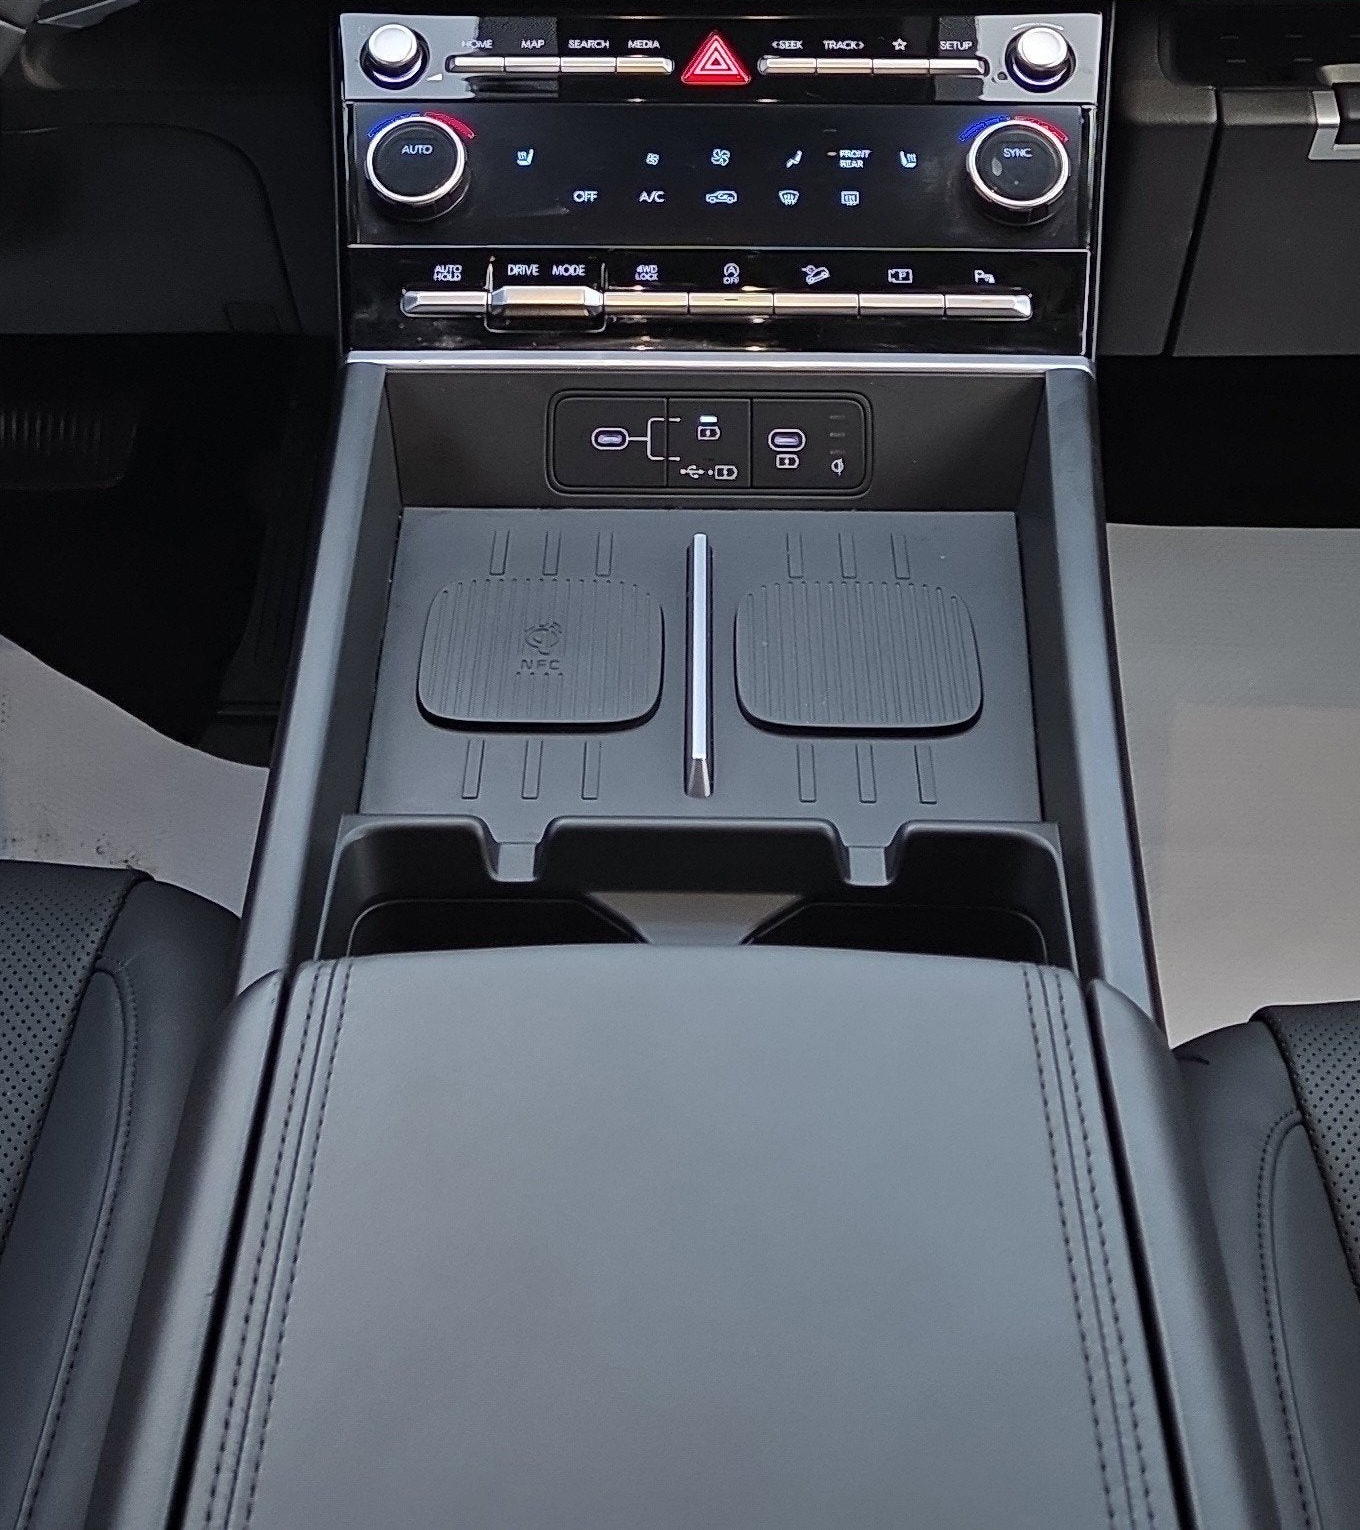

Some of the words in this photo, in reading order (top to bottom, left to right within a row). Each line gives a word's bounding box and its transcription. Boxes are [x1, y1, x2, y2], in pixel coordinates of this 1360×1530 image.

[461, 39, 493, 49] HOME
[520, 39, 545, 49] MAP
[567, 39, 610, 49] SEARCH
[627, 39, 661, 49] MEDIA
[939, 40, 973, 51] SETUP
[401, 144, 433, 155] AUTO
[839, 149, 871, 158] FRONT
[1002, 147, 1034, 159] SYNC
[839, 159, 864, 168] REAR
[572, 189, 599, 203] OFF
[638, 189, 666, 203] A/C
[434, 263, 463, 273] AUTO
[507, 263, 540, 277] DRIVE
[551, 264, 586, 277] MODE
[636, 264, 658, 273] 4WD
[432, 273, 463, 282] HOLD
[634, 272, 658, 281] LOCK
[722, 276, 740, 285] OFF
[520, 659, 561, 670] NFC
